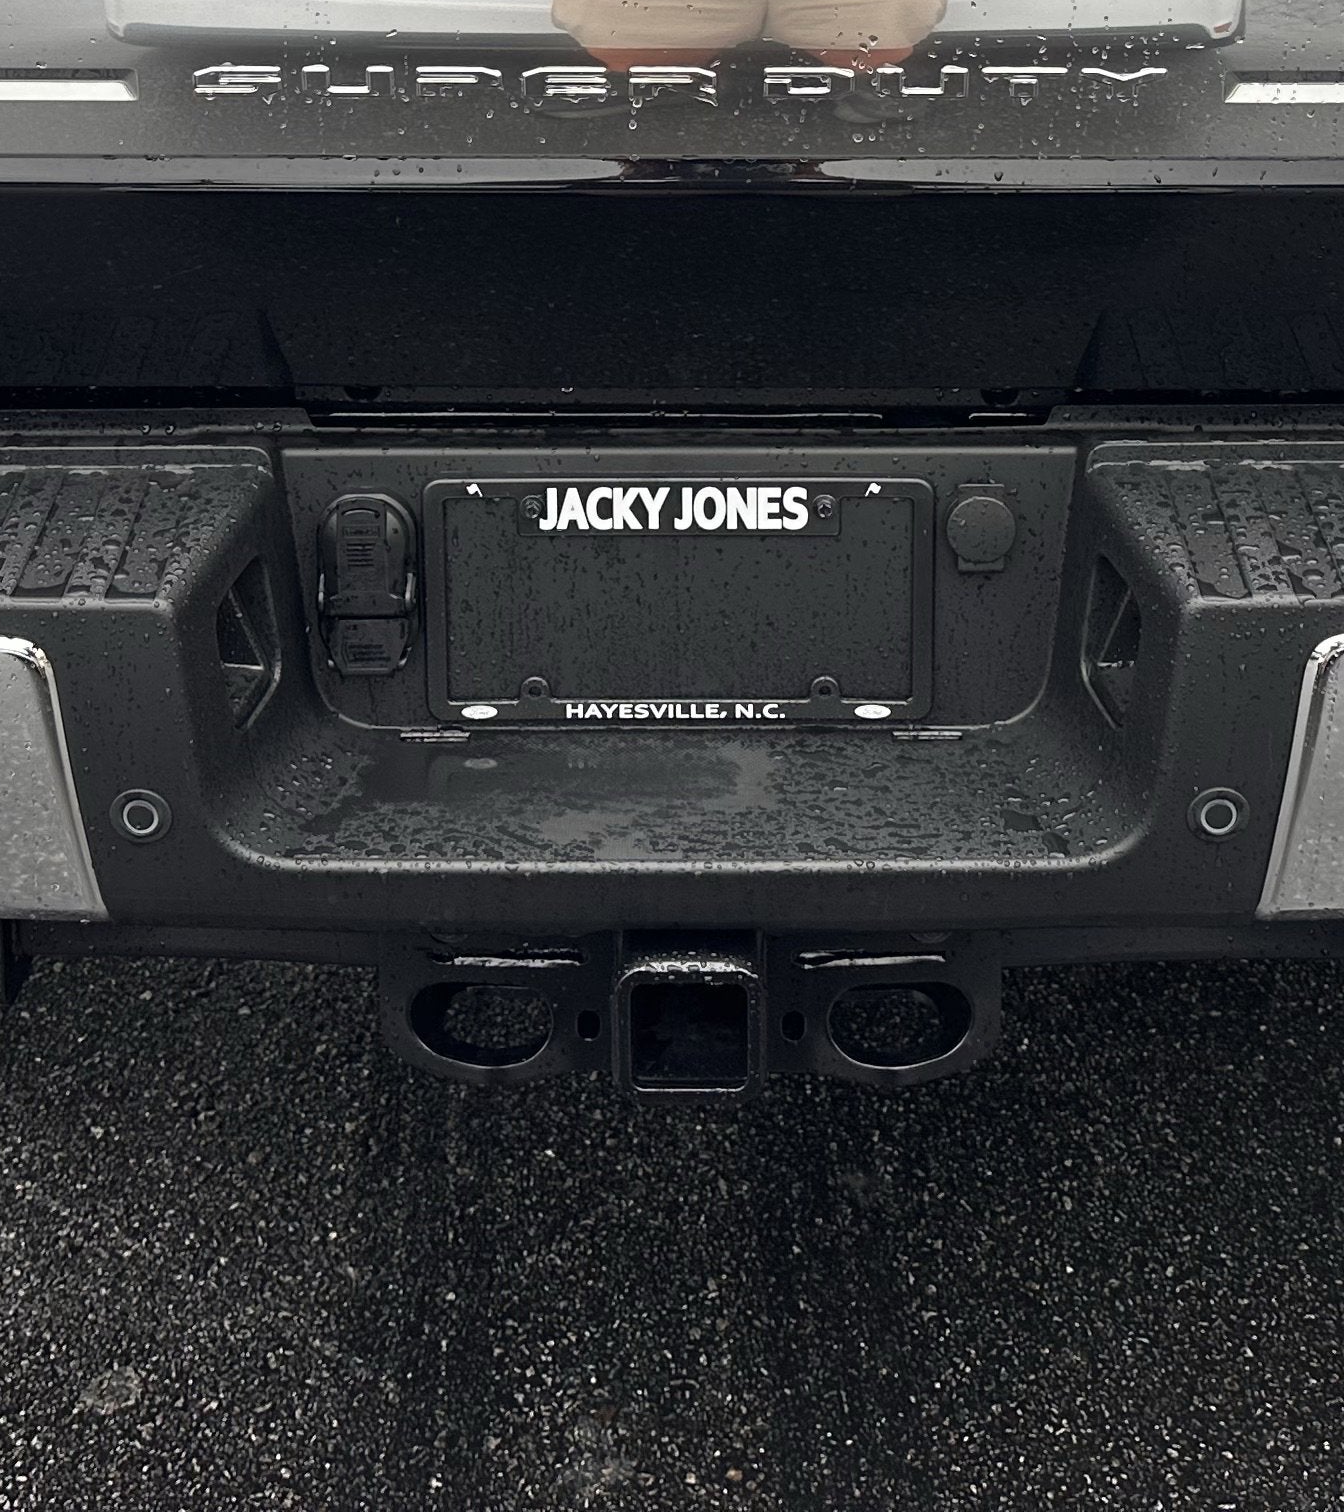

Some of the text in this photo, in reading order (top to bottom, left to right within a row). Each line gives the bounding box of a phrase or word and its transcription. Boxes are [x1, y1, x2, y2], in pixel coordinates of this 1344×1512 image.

[192, 64, 1168, 104] SUPER DUTY
[539, 486, 809, 531] JACKY JONES
[565, 703, 786, 719] HAYESVILLE, N.C.
